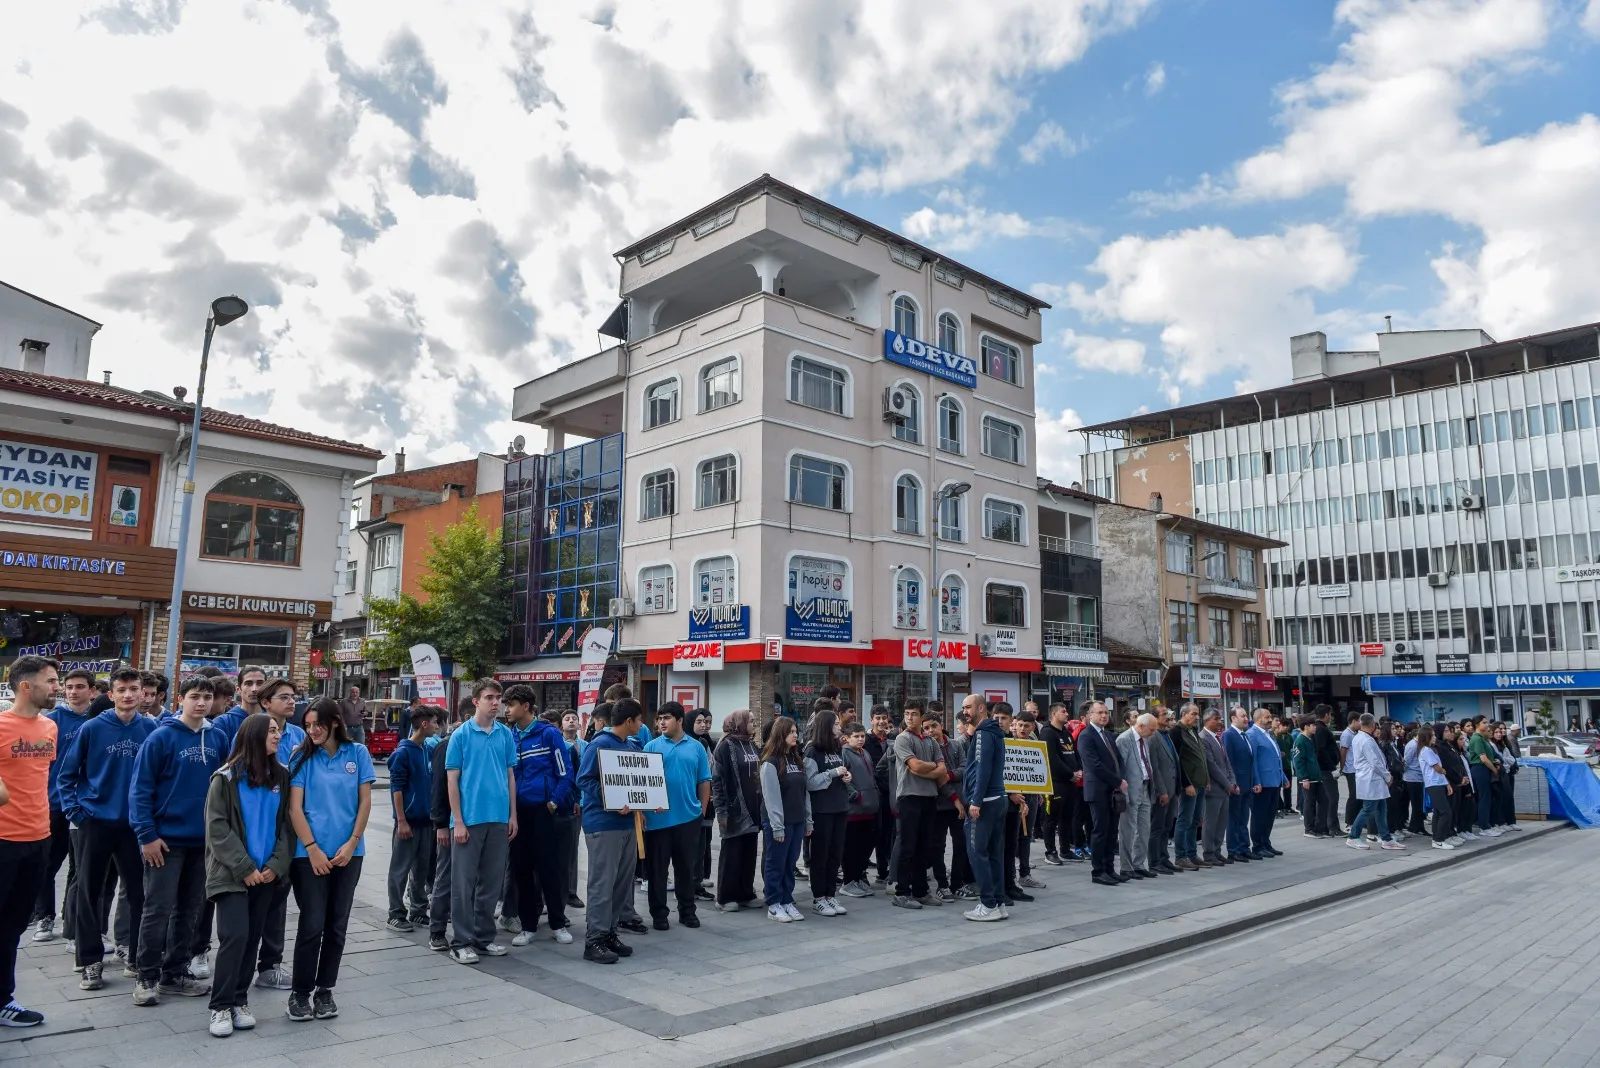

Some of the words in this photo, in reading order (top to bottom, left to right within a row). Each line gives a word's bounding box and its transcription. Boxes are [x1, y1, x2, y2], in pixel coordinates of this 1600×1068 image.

[905, 338, 977, 375] DEVA
[0, 444, 92, 471] YDAN
[0, 487, 89, 516] OKOPİ
[0, 551, 38, 568] DAN
[42, 555, 126, 575] KIRTASİYE
[188, 594, 239, 610] CEBECİ
[242, 598, 316, 617] KURUYEMİŞ
[711, 604, 741, 623] MUMCU
[817, 598, 849, 618] MUMCU
[19, 635, 100, 657] MEYDAN
[673, 642, 721, 659] ECZANE
[769, 641, 778, 656] E
[58, 659, 113, 673] TASİYE
[929, 661, 946, 669] EİM
[1510, 675, 1575, 686] HALKBANK
[617, 754, 649, 769] TAŞKÖPRÜ
[604, 773, 631, 786] ANADOLU
[631, 772, 648, 787] İMAM
[647, 774, 664, 788] HATİP
[627, 789, 648, 804] LİSESİ
